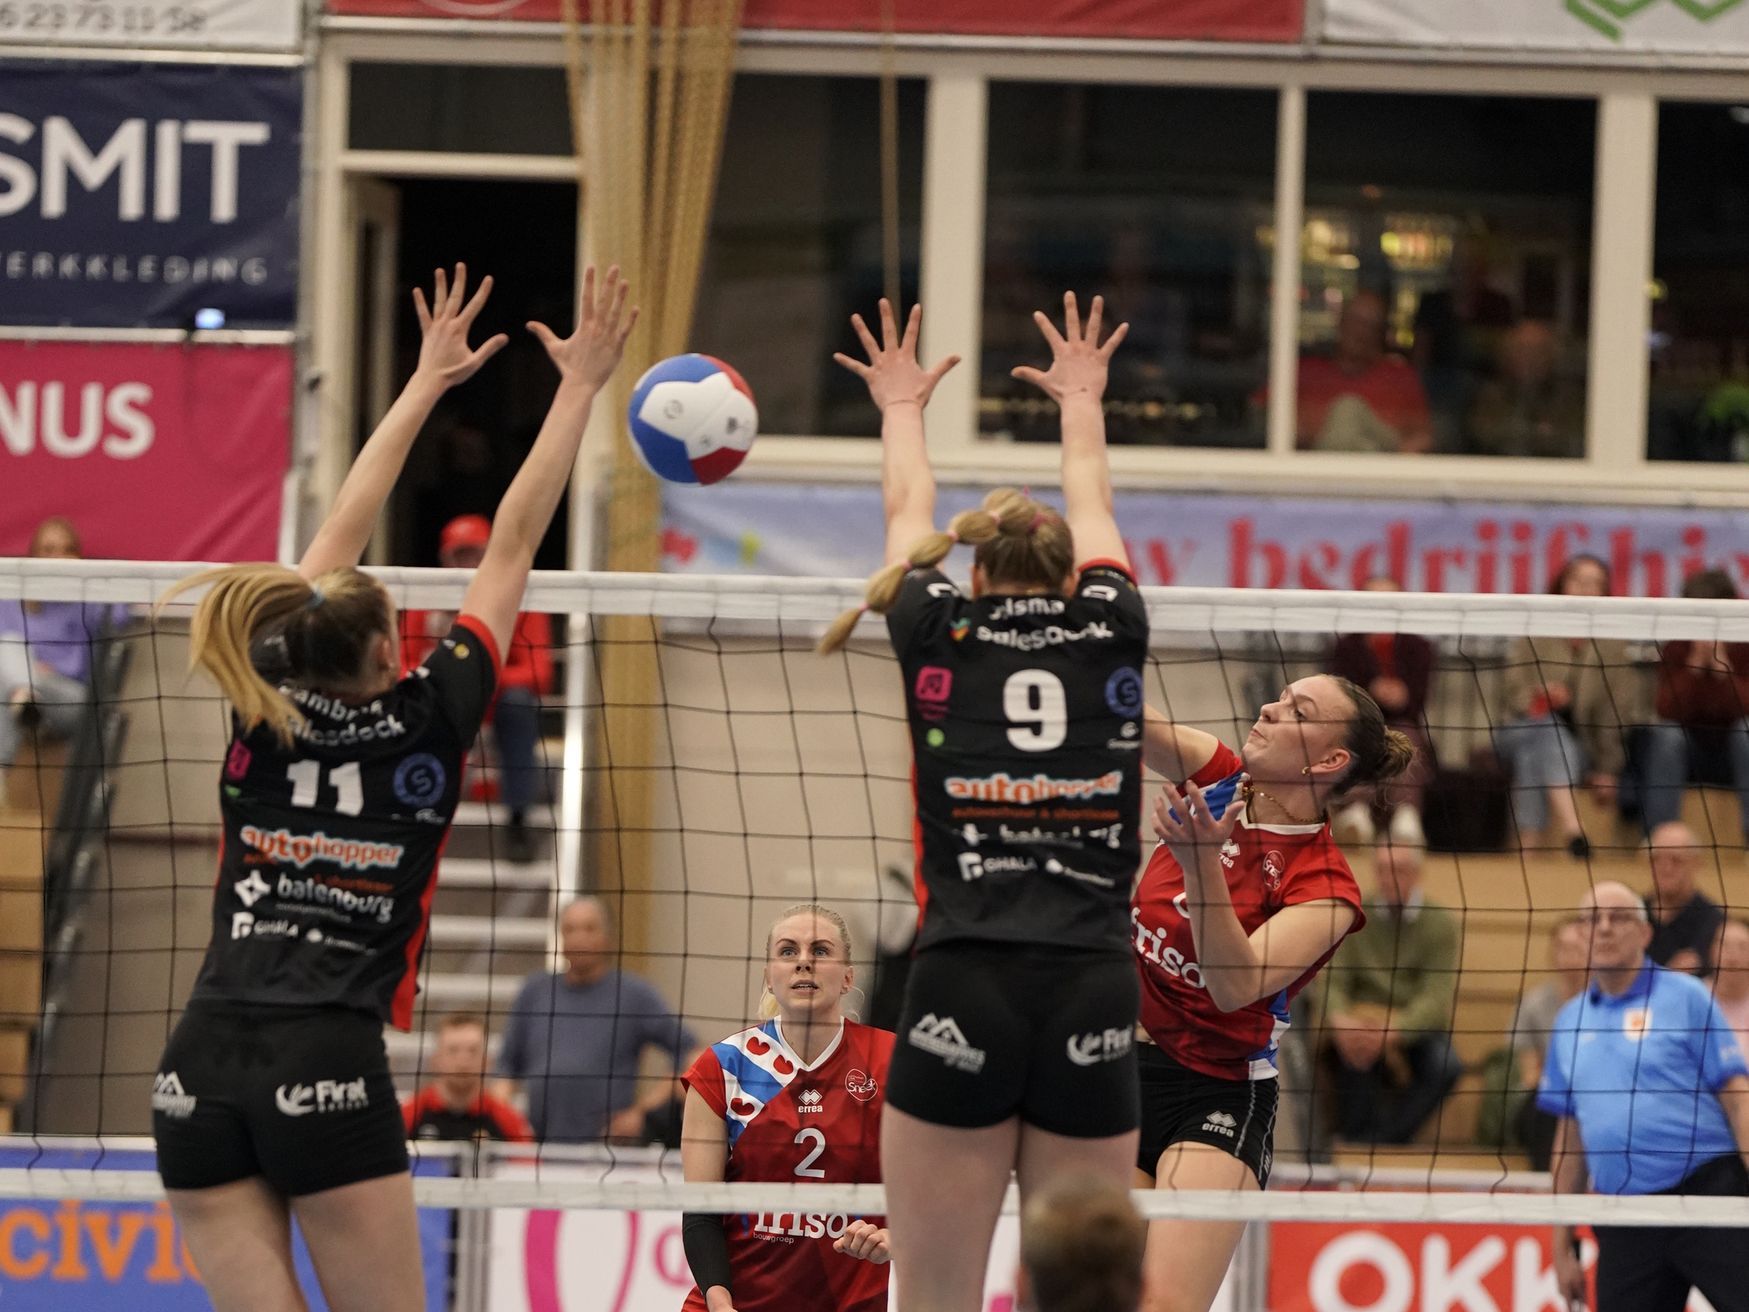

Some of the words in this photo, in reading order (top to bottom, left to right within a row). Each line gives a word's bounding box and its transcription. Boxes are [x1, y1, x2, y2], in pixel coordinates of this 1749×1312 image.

[0, 112, 271, 223] SMIT
[0, 251, 268, 286] ERKKLEDING
[0, 380, 155, 460] NUS
[1003, 668, 1068, 752] 9
[286, 759, 365, 817] 11
[240, 825, 405, 871] autohopper
[1131, 906, 1206, 989] friso
[793, 1127, 826, 1179] 2
[753, 1232, 795, 1245] bouwgroep
